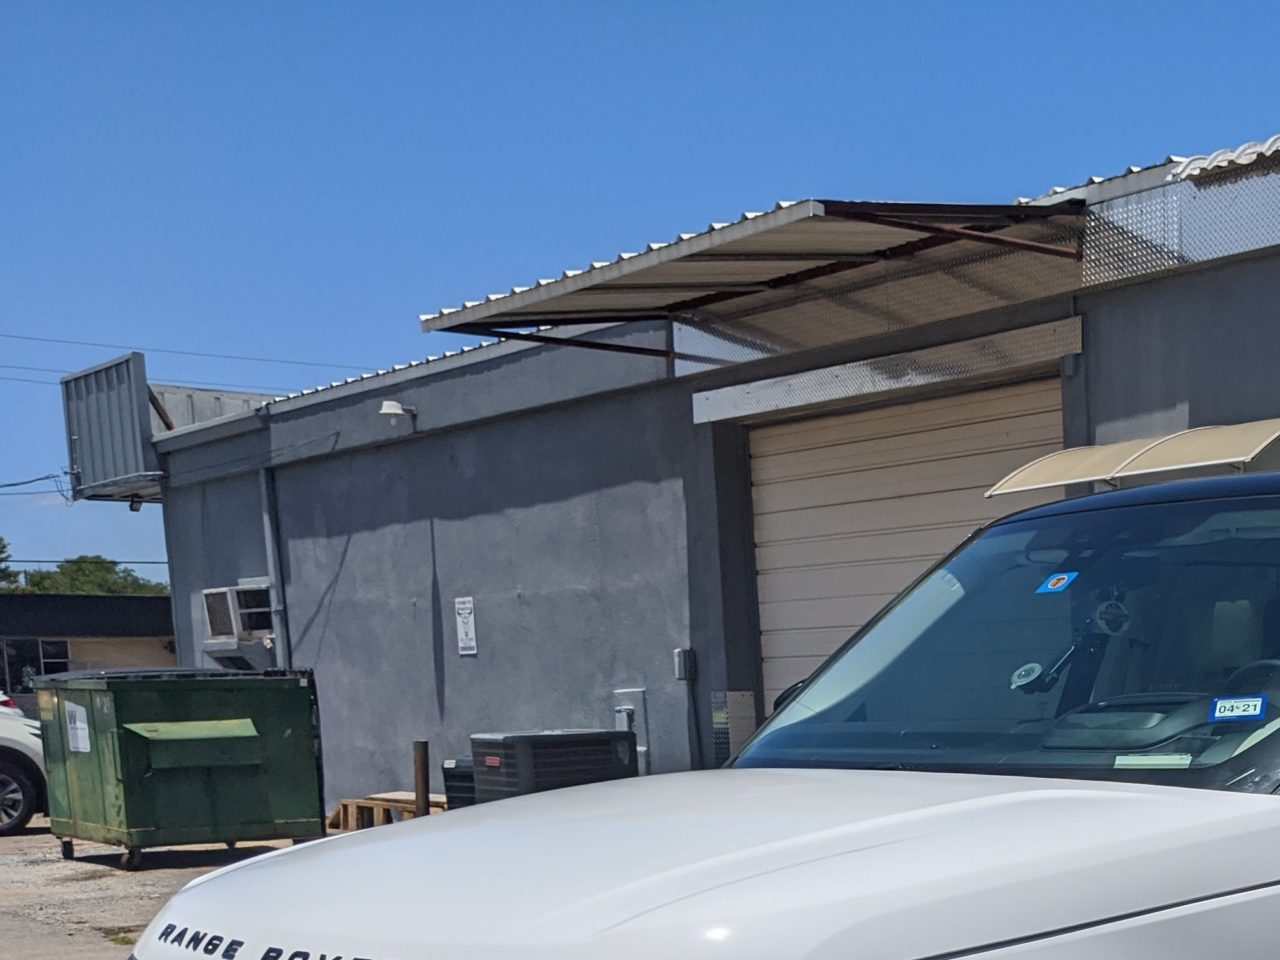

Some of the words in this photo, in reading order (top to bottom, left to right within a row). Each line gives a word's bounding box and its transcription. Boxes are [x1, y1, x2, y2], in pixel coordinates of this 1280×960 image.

[1218, 704, 1235, 714] 04
[1242, 703, 1258, 713] 21
[158, 923, 245, 960] RANGE
